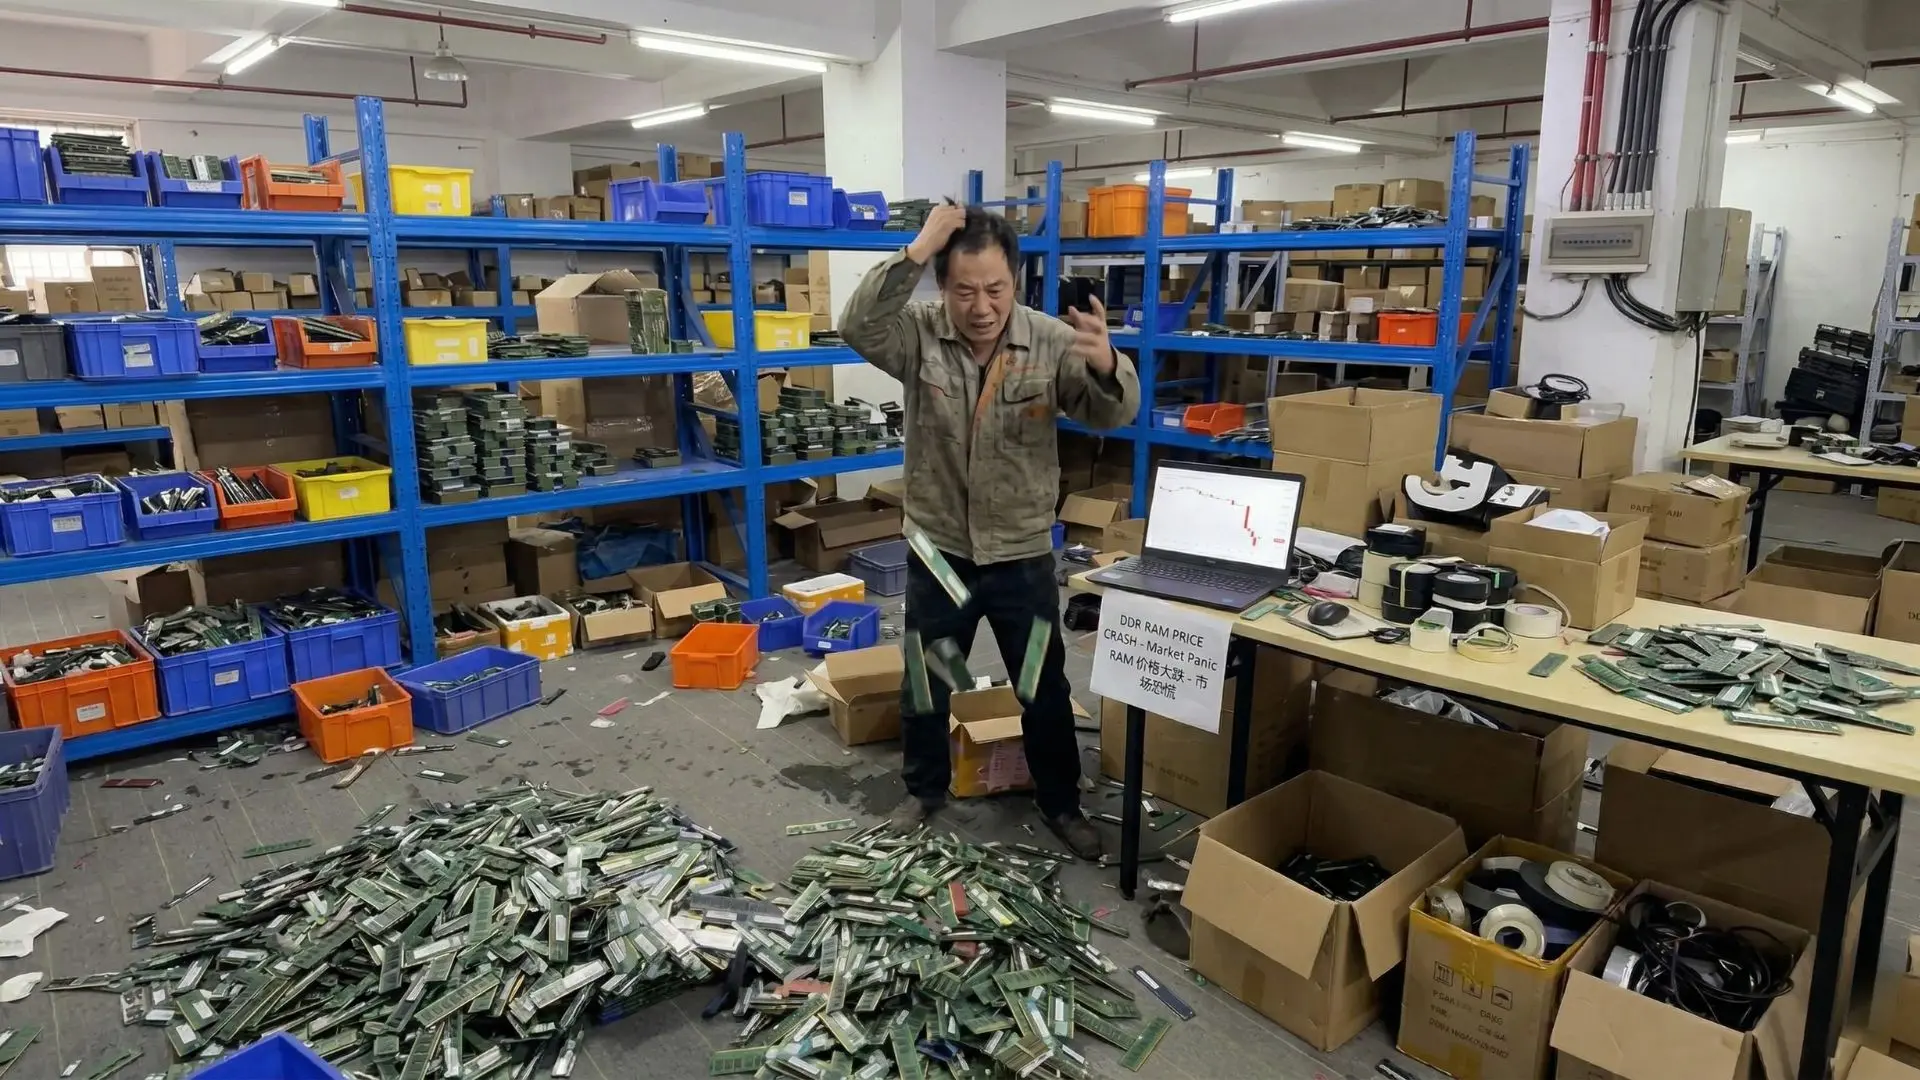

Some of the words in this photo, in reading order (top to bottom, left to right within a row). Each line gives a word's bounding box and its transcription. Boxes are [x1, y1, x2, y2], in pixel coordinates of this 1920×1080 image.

[1103, 628, 1137, 647] CRASH
[1146, 640, 1184, 662] Market
[1187, 652, 1218, 671] Panic
[1120, 614, 1141, 629] DDR
[1145, 621, 1169, 638] RAM
[1172, 629, 1204, 648] PRICE
[1109, 649, 1133, 666] RAM
[1195, 674, 1208, 690] 市
